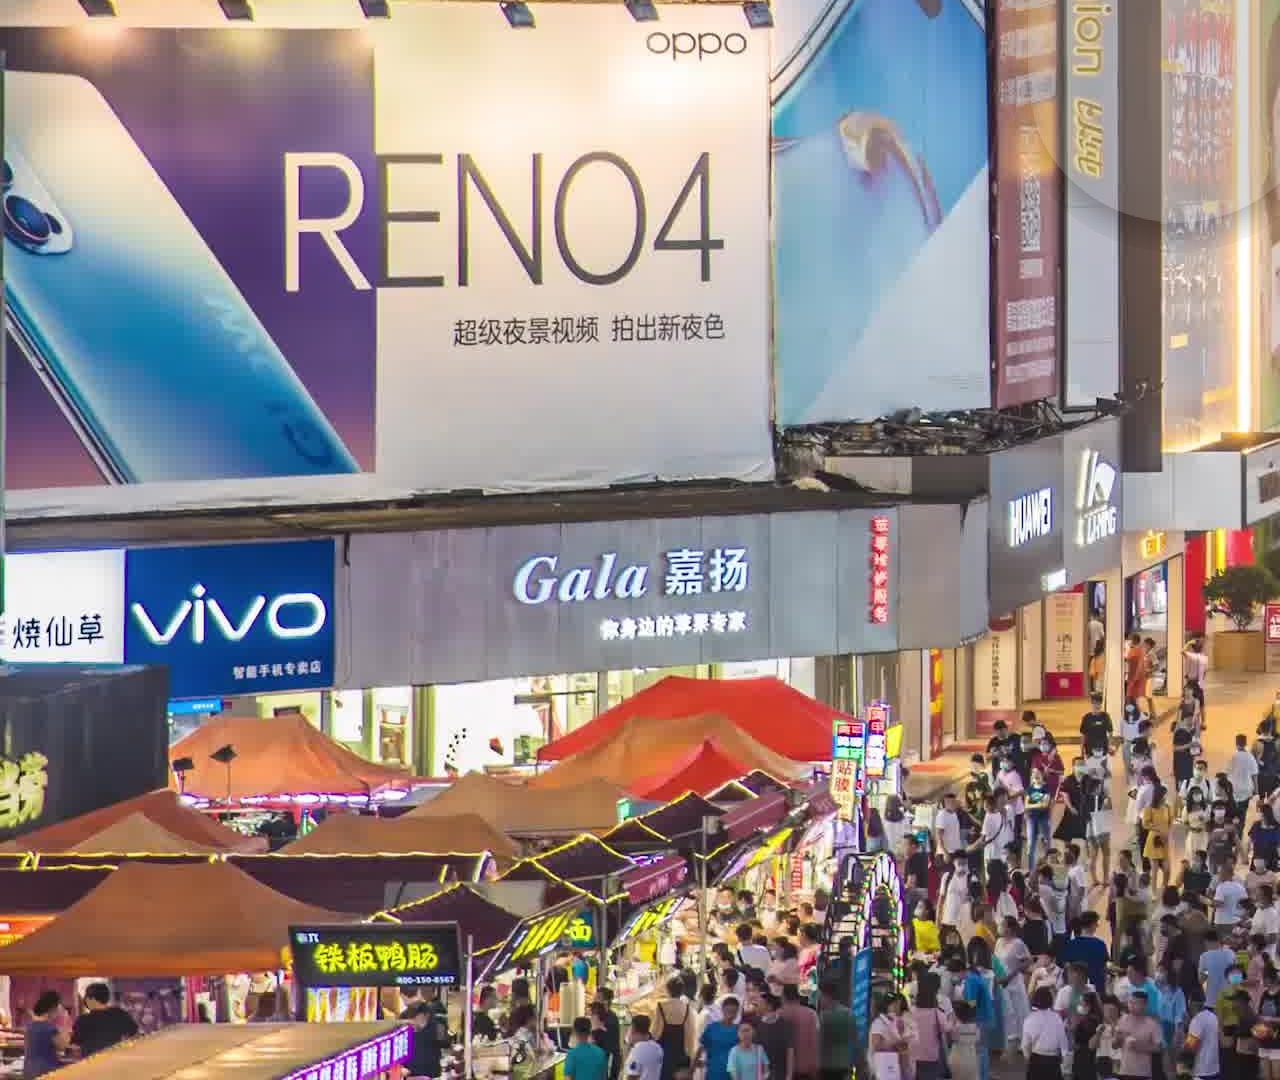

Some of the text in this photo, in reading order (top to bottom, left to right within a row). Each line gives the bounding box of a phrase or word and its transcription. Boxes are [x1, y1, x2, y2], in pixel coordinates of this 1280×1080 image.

[283, 150, 725, 293] RENO4
[452, 312, 727, 347] 超级夜景视频 拍出新夜色
[1009, 487, 1052, 549] HUAWEI
[512, 547, 749, 605] Gala 嘉扬
[131, 582, 327, 645] vivo
[313, 942, 440, 973] 铁板鸭肠
